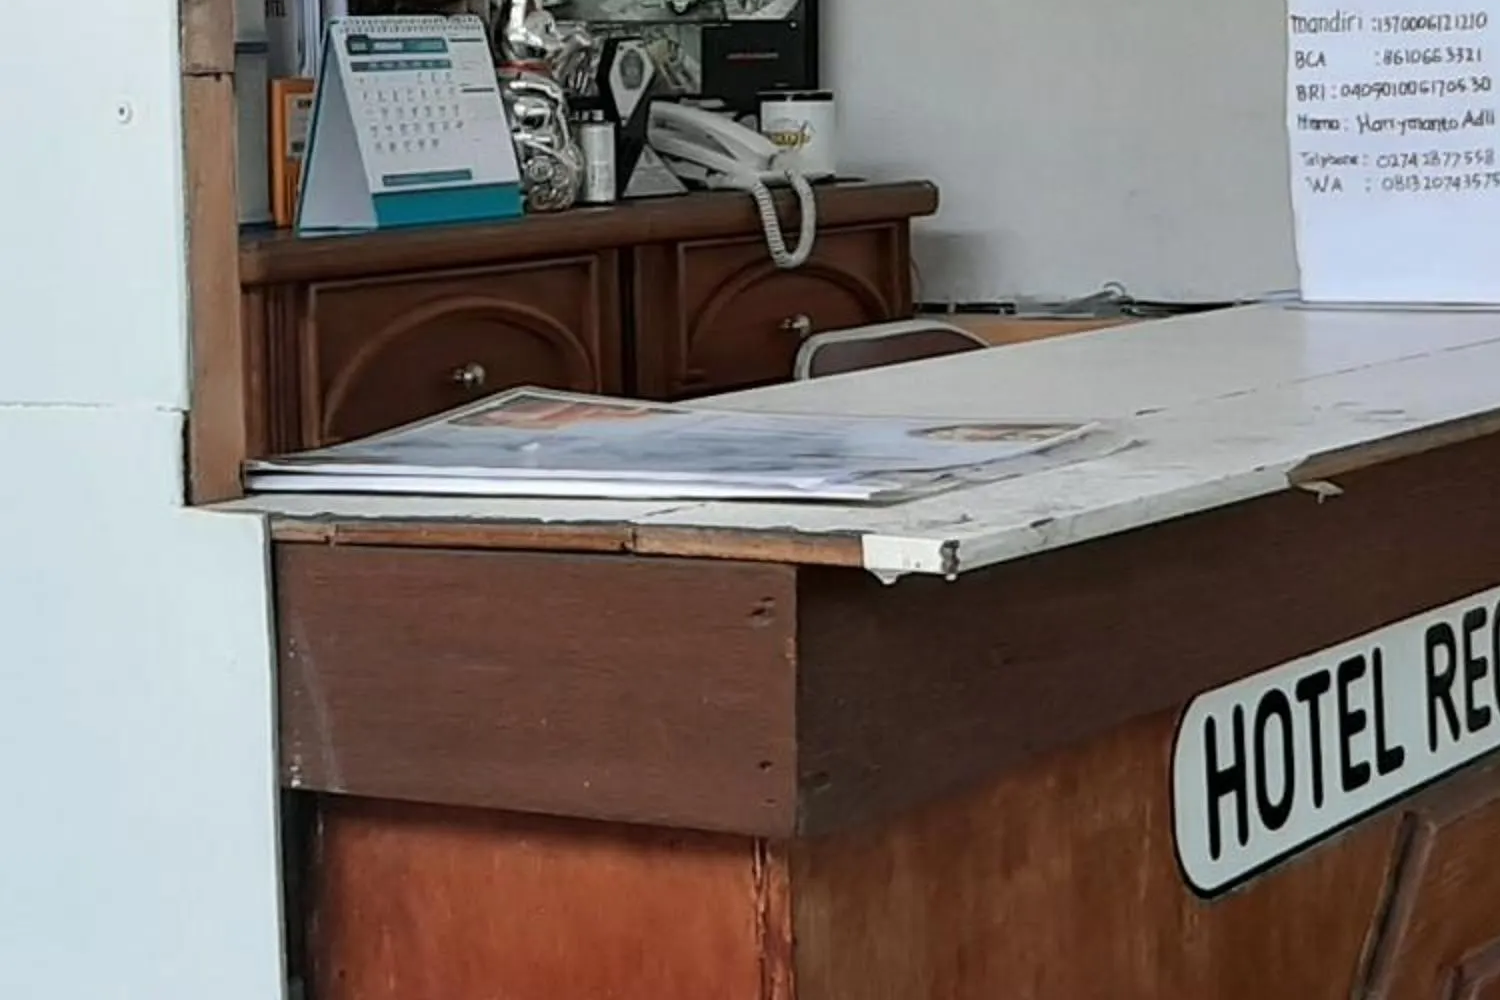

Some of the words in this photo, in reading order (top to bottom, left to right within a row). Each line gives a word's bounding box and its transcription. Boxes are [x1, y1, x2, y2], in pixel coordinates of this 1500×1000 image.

[1294, 50, 1328, 69] BCA
[1296, 83, 1326, 102] BRI
[1204, 647, 1405, 861] HOTEL
